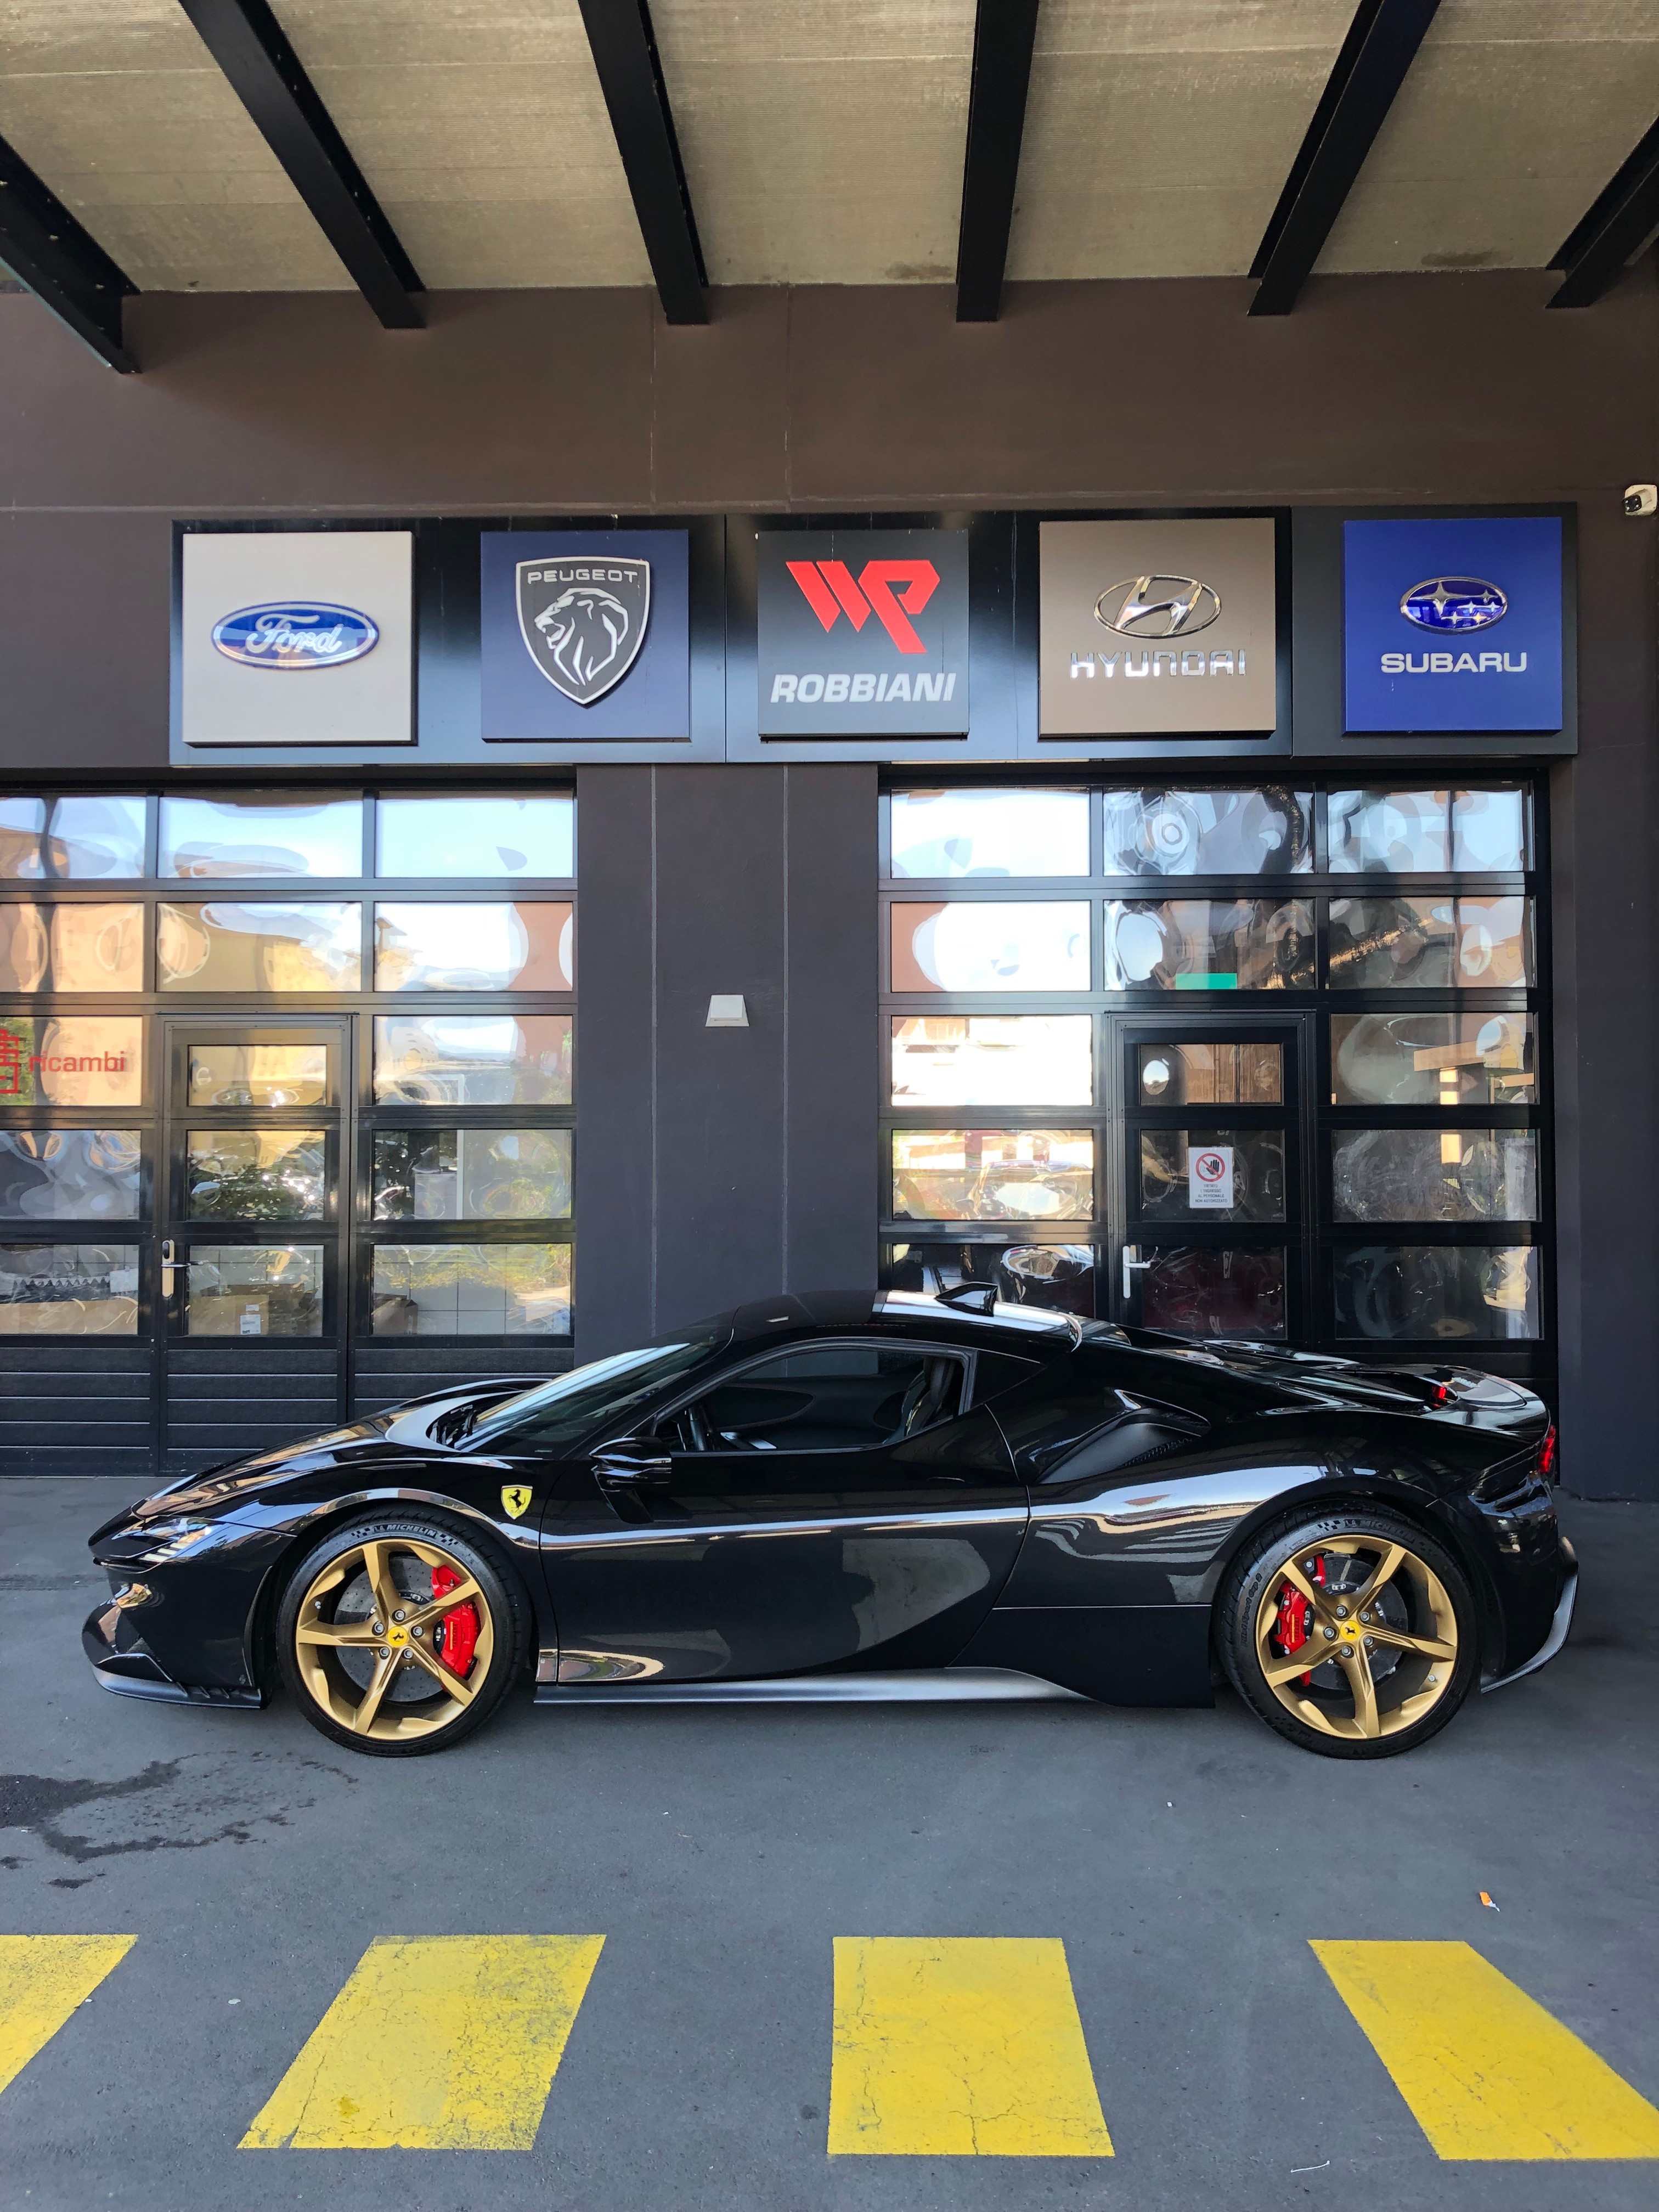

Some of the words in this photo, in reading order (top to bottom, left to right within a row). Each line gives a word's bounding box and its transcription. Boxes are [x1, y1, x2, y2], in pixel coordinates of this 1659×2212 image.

[527, 568, 638, 585] PEUGEOT
[246, 613, 345, 653] Ford
[1070, 649, 1246, 679] HYUNDAI
[1380, 652, 1527, 673] SUBARU
[770, 673, 957, 703] ROBBIANI
[29, 1051, 125, 1072] ricambi
[386, 1523, 437, 1538] MICHELIN
